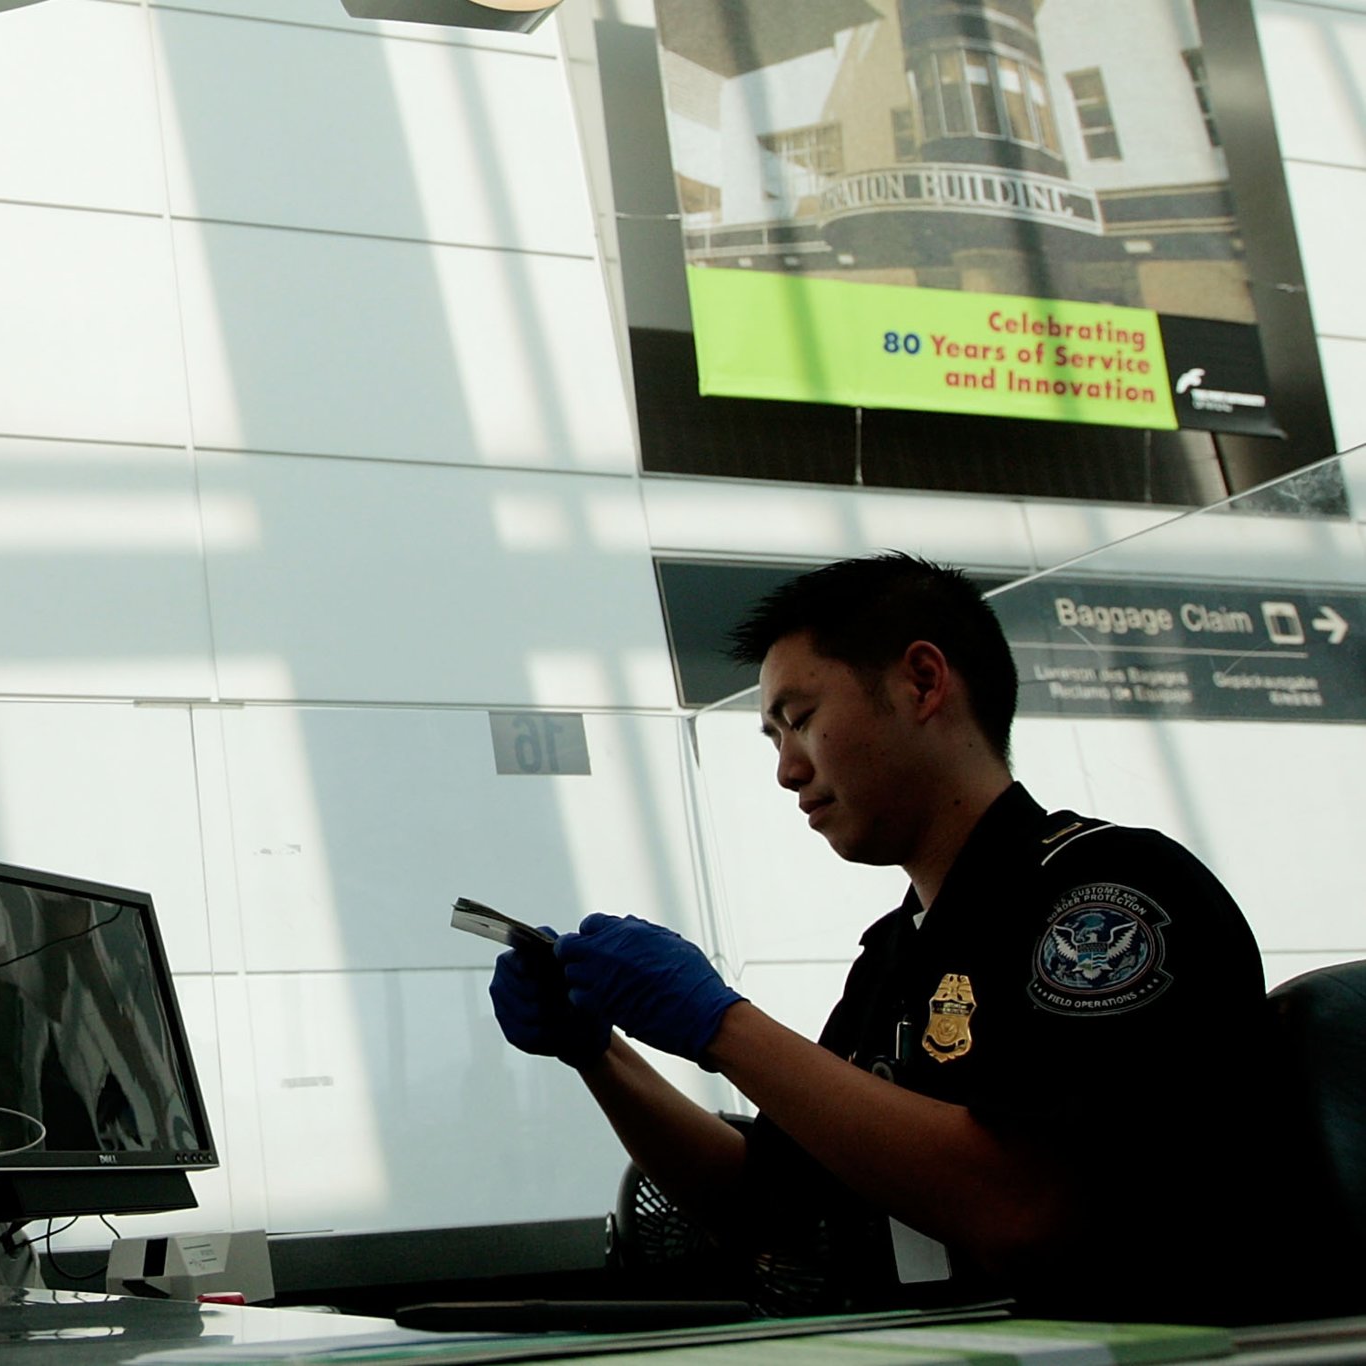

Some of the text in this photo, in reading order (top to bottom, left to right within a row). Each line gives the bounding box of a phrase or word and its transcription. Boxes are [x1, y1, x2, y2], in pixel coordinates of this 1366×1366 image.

[988, 310, 1146, 352] Celebrating
[882, 331, 1151, 375] 80 Years of Service
[944, 367, 997, 390] and
[1007, 370, 1156, 404] Innovation
[1054, 597, 1254, 636] Baggage Claim
[1071, 886, 1120, 898] CUSTOMS
[1084, 894, 1147, 915] PROTECTION
[1047, 991, 1138, 1009] FIELD OPERATIONS
